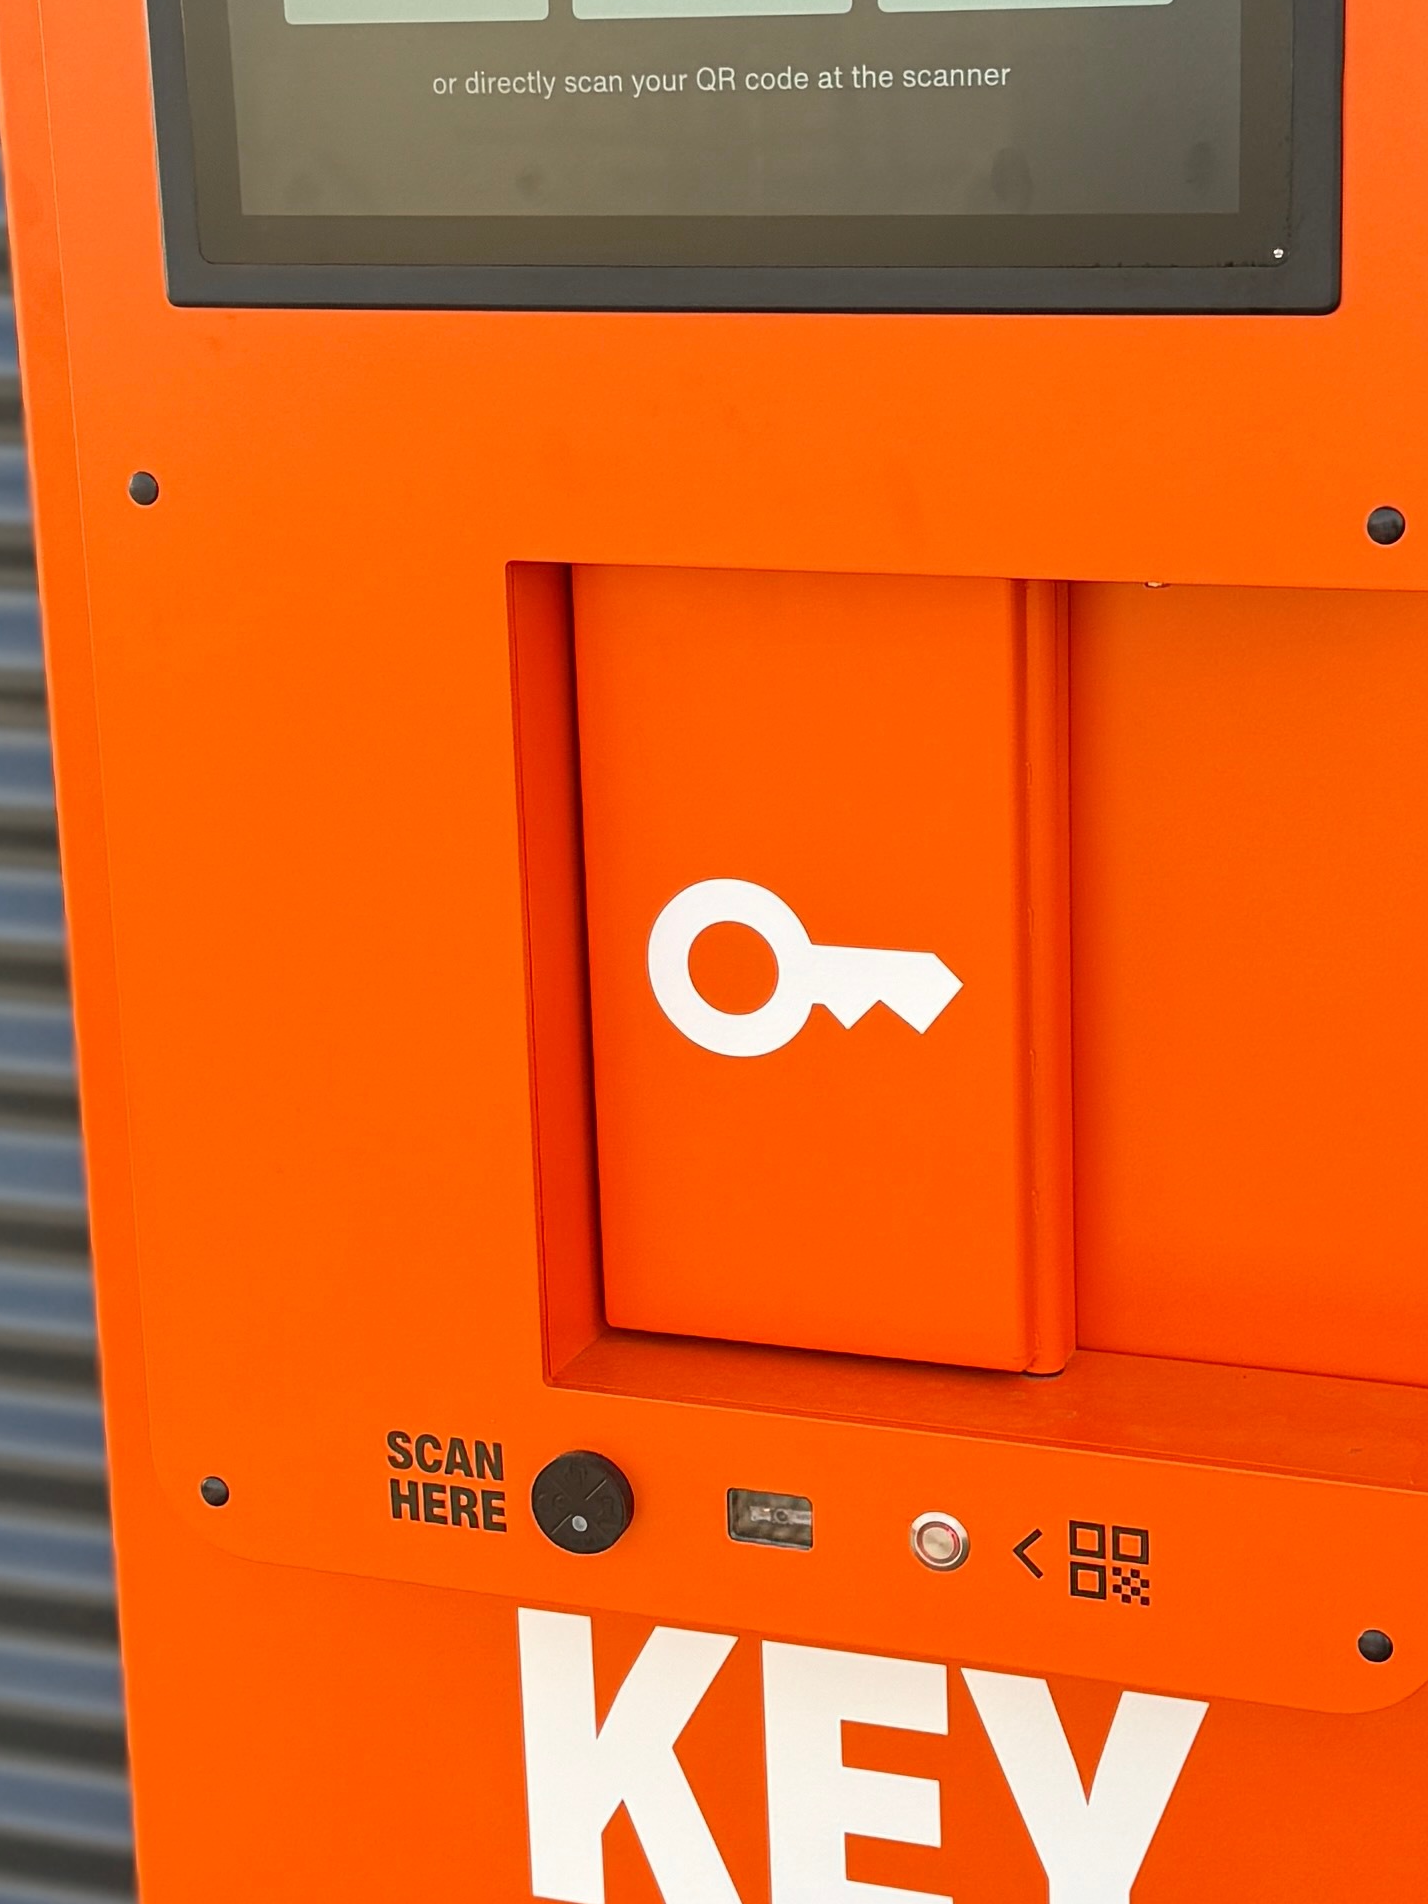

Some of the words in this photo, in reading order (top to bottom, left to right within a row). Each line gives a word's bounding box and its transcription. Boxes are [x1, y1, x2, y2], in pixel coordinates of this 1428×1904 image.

[432, 76, 458, 95] or
[465, 70, 556, 100] directly
[564, 74, 623, 93] scan
[631, 72, 688, 98] your
[696, 66, 737, 92] QR
[745, 66, 809, 90] code
[817, 66, 844, 89] at
[851, 64, 894, 89] the
[902, 67, 1011, 88] scanner
[386, 1430, 505, 1482] SCAN
[389, 1477, 508, 1533] HERE
